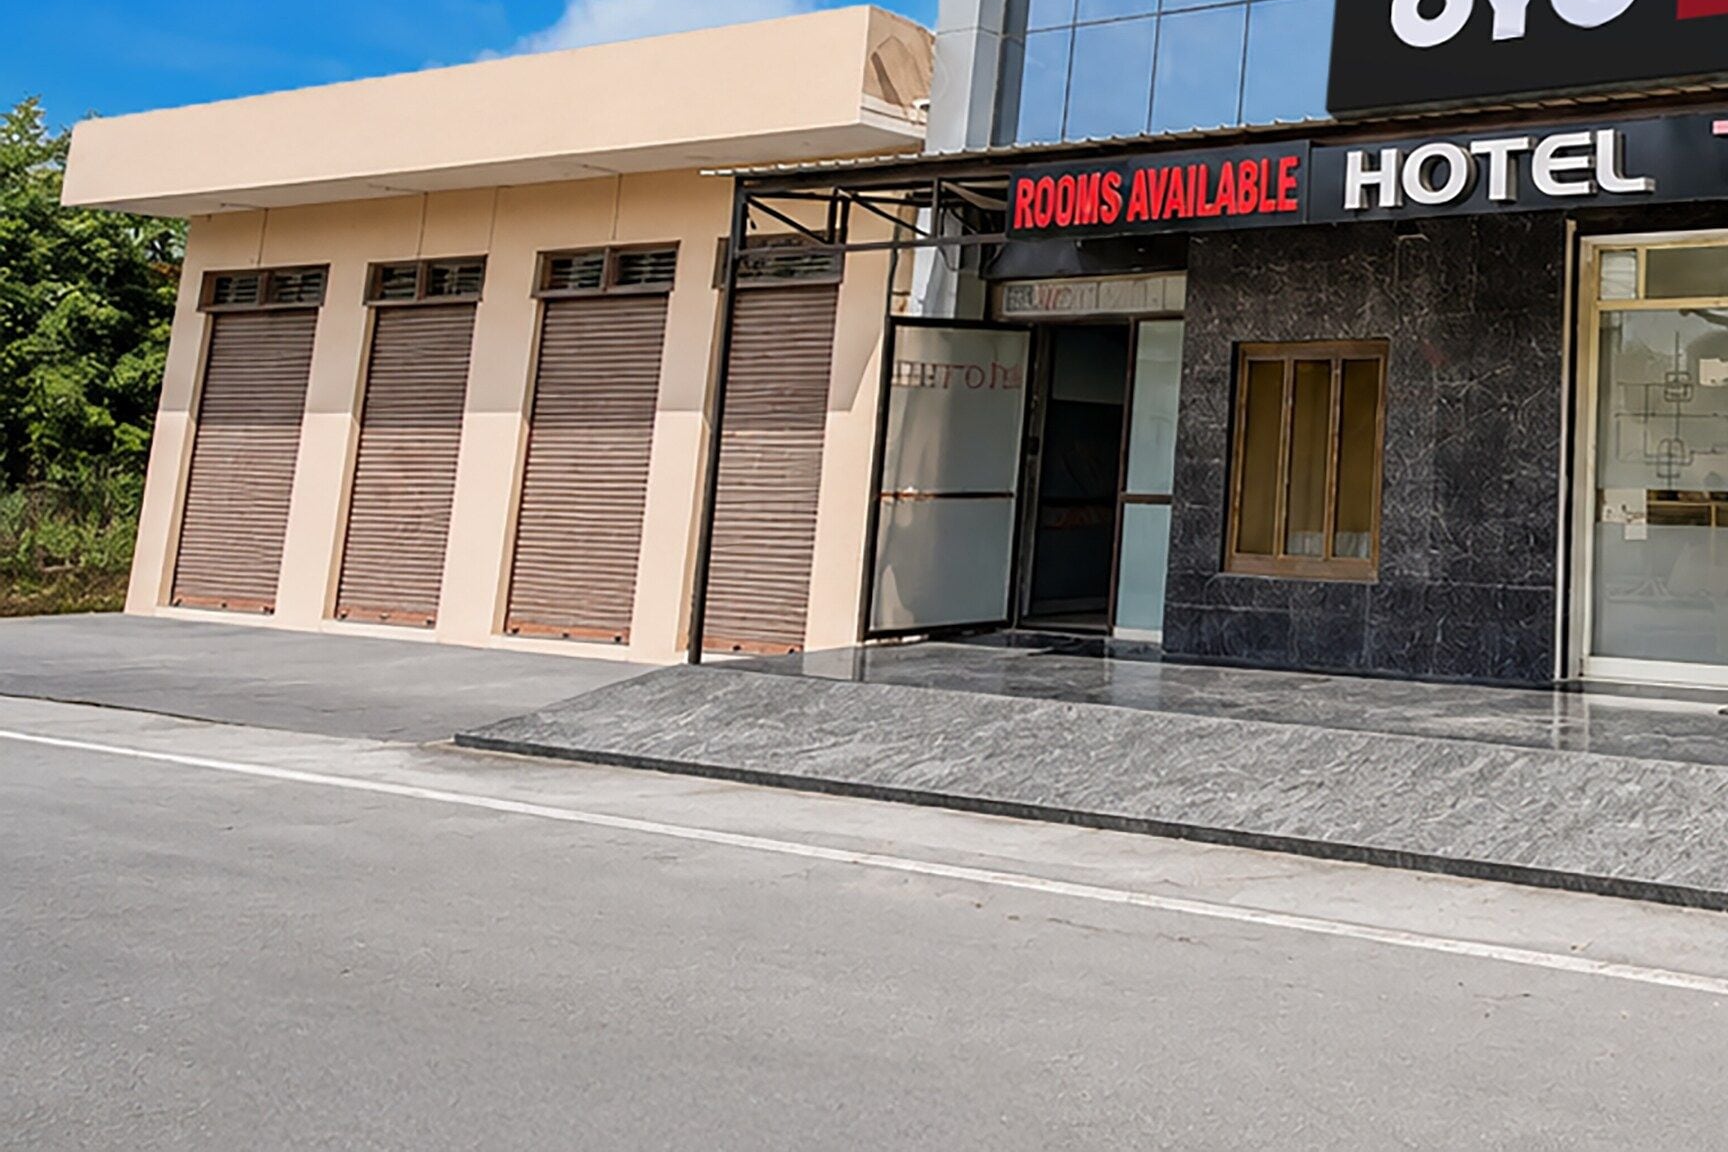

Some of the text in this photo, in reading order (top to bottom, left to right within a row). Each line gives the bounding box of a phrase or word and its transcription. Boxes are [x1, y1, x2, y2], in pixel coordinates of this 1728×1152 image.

[1013, 155, 1300, 230] ROOMS AVAILABLE
[1343, 128, 1656, 211] HOTEL
